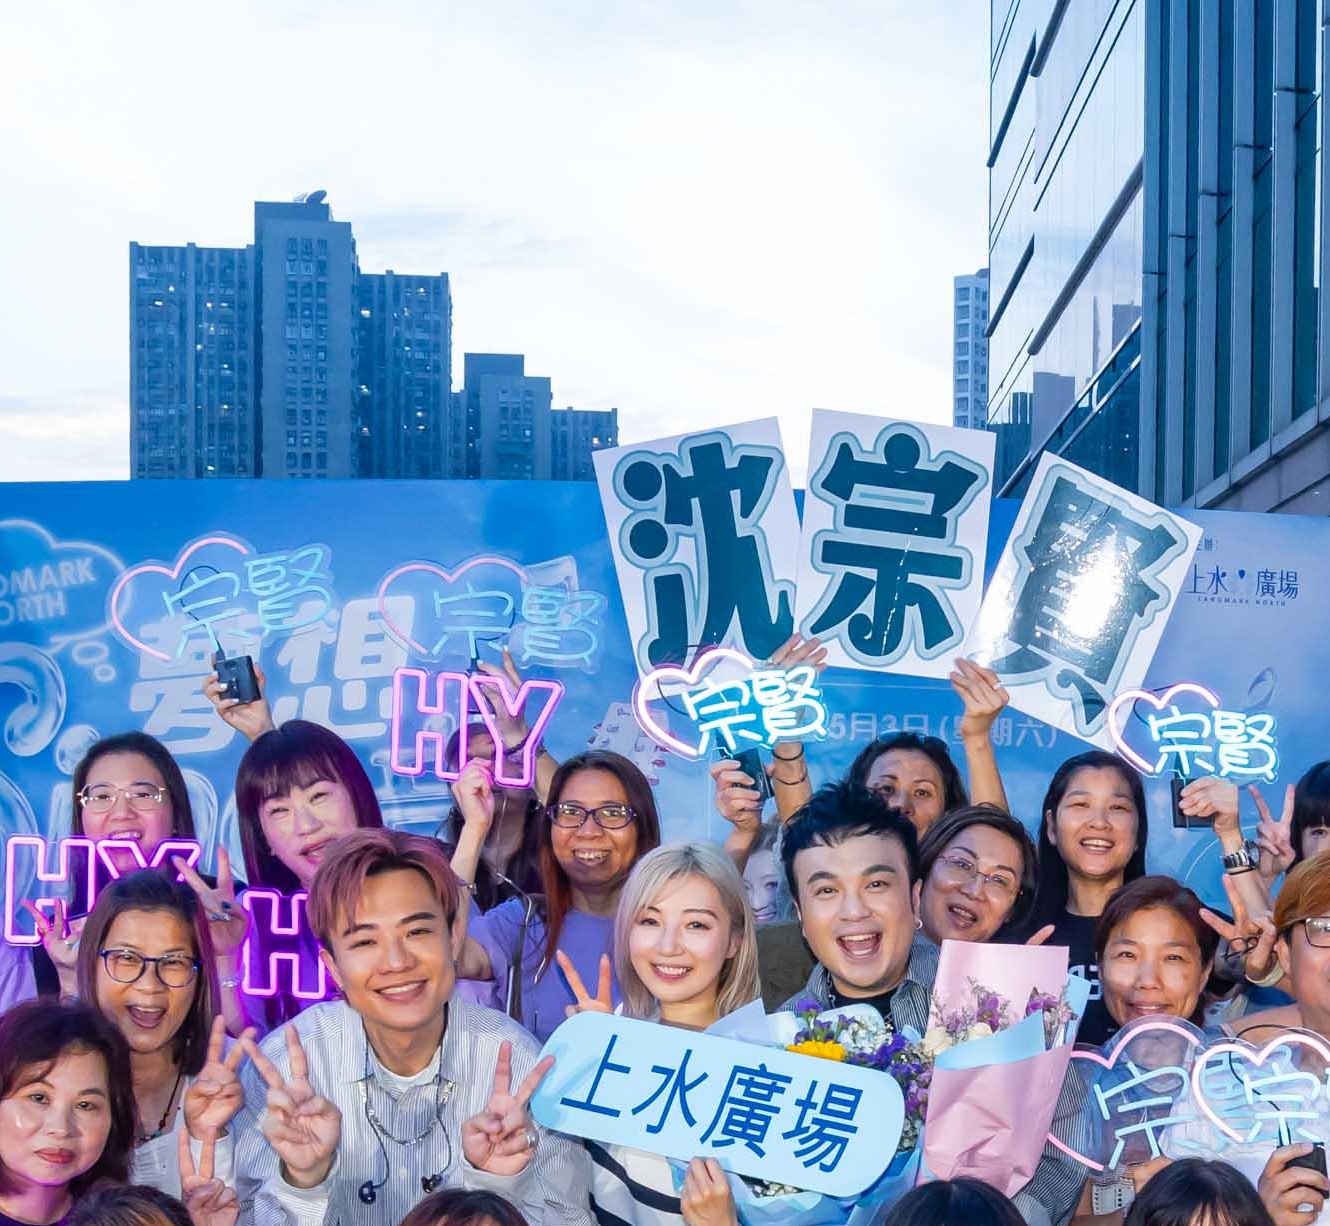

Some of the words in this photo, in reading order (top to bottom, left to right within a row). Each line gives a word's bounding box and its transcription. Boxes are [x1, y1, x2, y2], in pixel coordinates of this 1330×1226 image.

[389, 666, 565, 788] HY
[681, 662, 831, 756] 宗賢
[1148, 704, 1278, 782] 宗賢
[559, 1033, 864, 1173] 上水廣場
